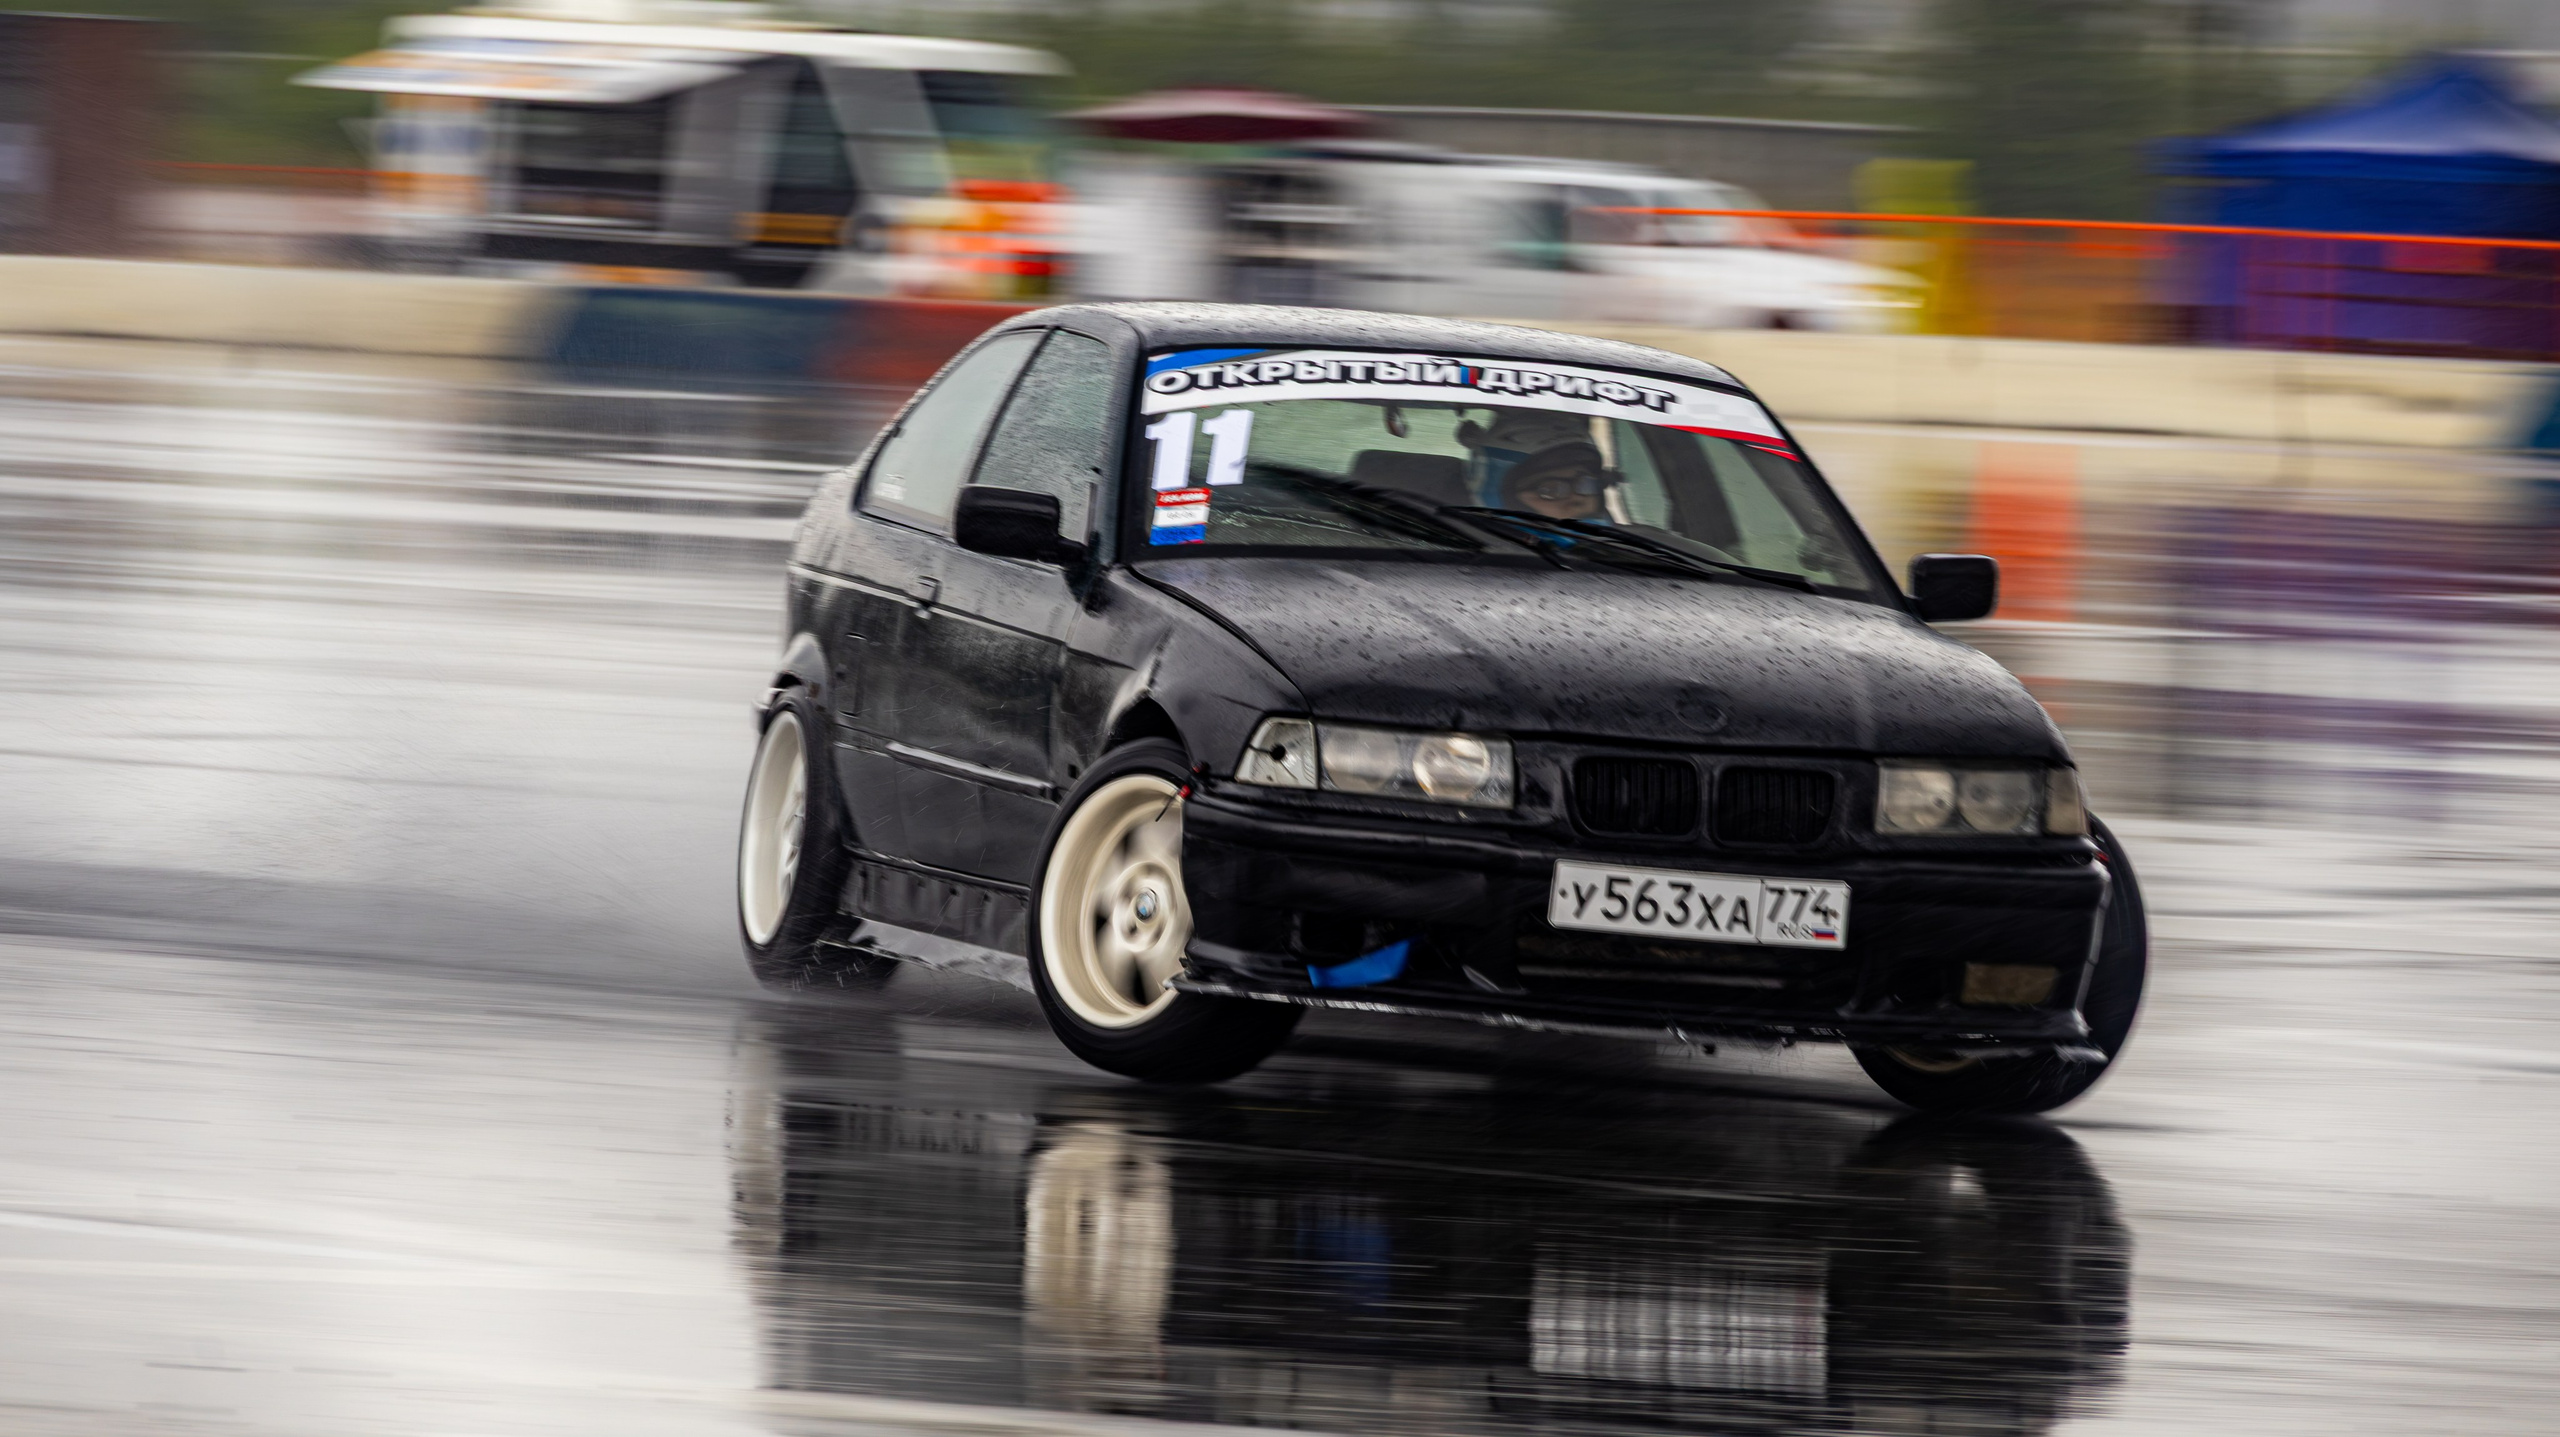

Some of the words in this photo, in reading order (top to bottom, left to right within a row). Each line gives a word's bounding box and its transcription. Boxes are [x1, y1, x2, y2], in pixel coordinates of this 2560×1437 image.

[1146, 358, 1463, 394] ОТКРЫТЫЙ
[1477, 367, 1677, 412] ДРИФТ
[1145, 409, 1254, 490] 11
[1766, 886, 1836, 925] 774
[1777, 921, 1814, 940] RUS
